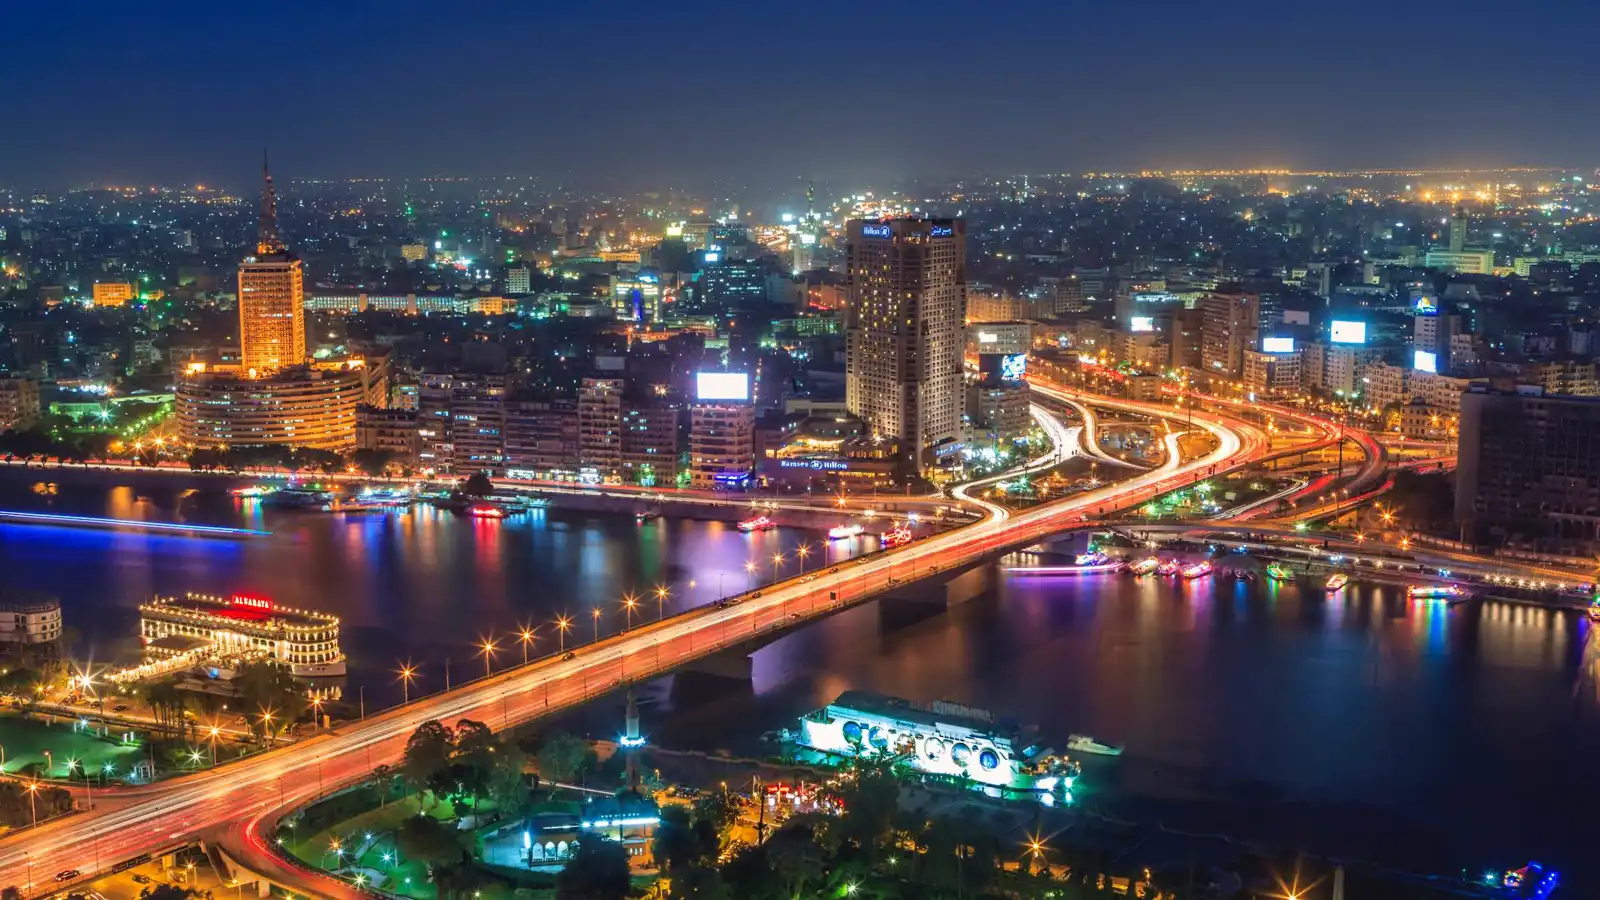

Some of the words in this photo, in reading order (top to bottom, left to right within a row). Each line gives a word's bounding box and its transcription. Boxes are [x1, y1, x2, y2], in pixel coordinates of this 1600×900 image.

[863, 226, 880, 235] Hilton
[781, 460, 809, 468] Ramses
[824, 461, 847, 469] Hilton
